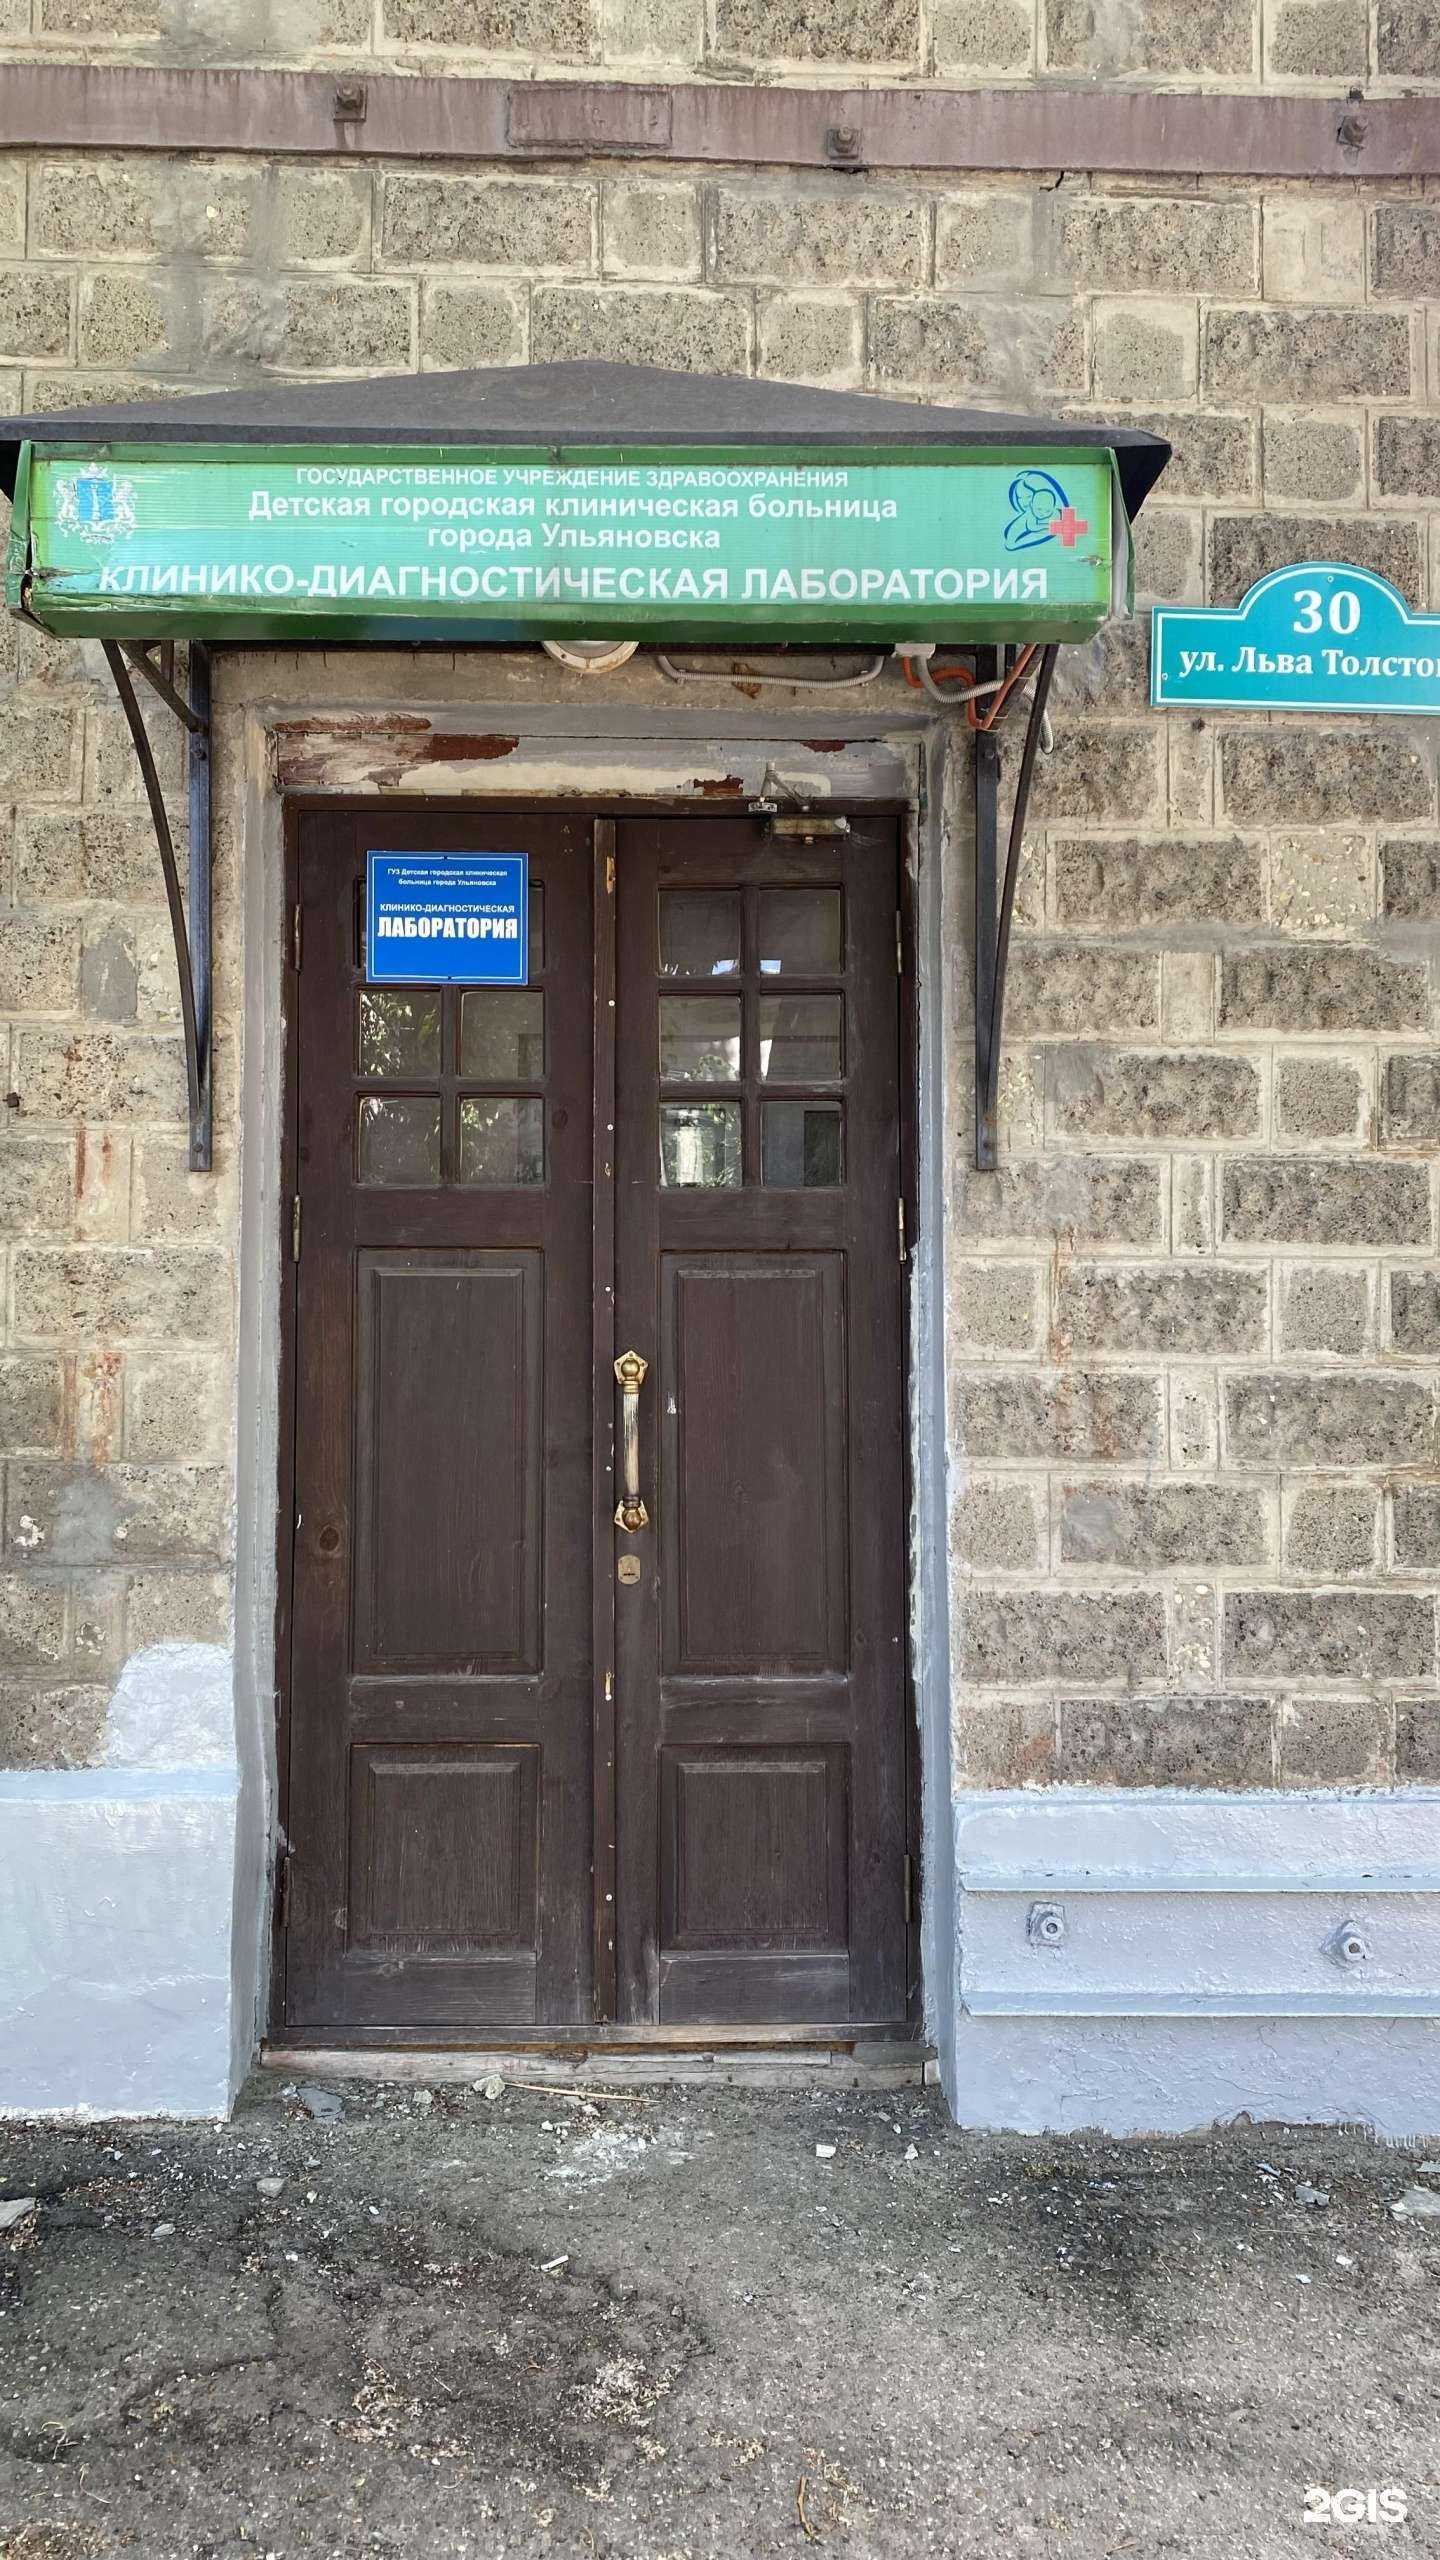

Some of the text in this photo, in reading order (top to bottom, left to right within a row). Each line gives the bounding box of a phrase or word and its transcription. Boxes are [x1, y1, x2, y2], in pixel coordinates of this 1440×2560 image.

[296, 467, 848, 488] ГОСУДАРСТВЕННОЕ УЧРЕЖДЕНИЕ ЗДРАВООХРАНЕНИЯ
[249, 491, 898, 519] Детская городская клиническая больница
[428, 523, 721, 552] города Ульяновска
[99, 563, 1049, 600] КЛИНИКО-ДИАГНОСТИЧЕСКАЯ ЛАБОРАТОРИЯ
[1293, 590, 1361, 634] 30
[1178, 646, 1440, 678] ул. Льва Толсто
[401, 868, 429, 876] Детская
[457, 879, 497, 887] Ульяновска
[380, 903, 515, 913] КЛИНИКО-ДИАГНОСТИЧЕСКАЯ
[377, 916, 518, 939] ЛАБОРАТОРИЯ
